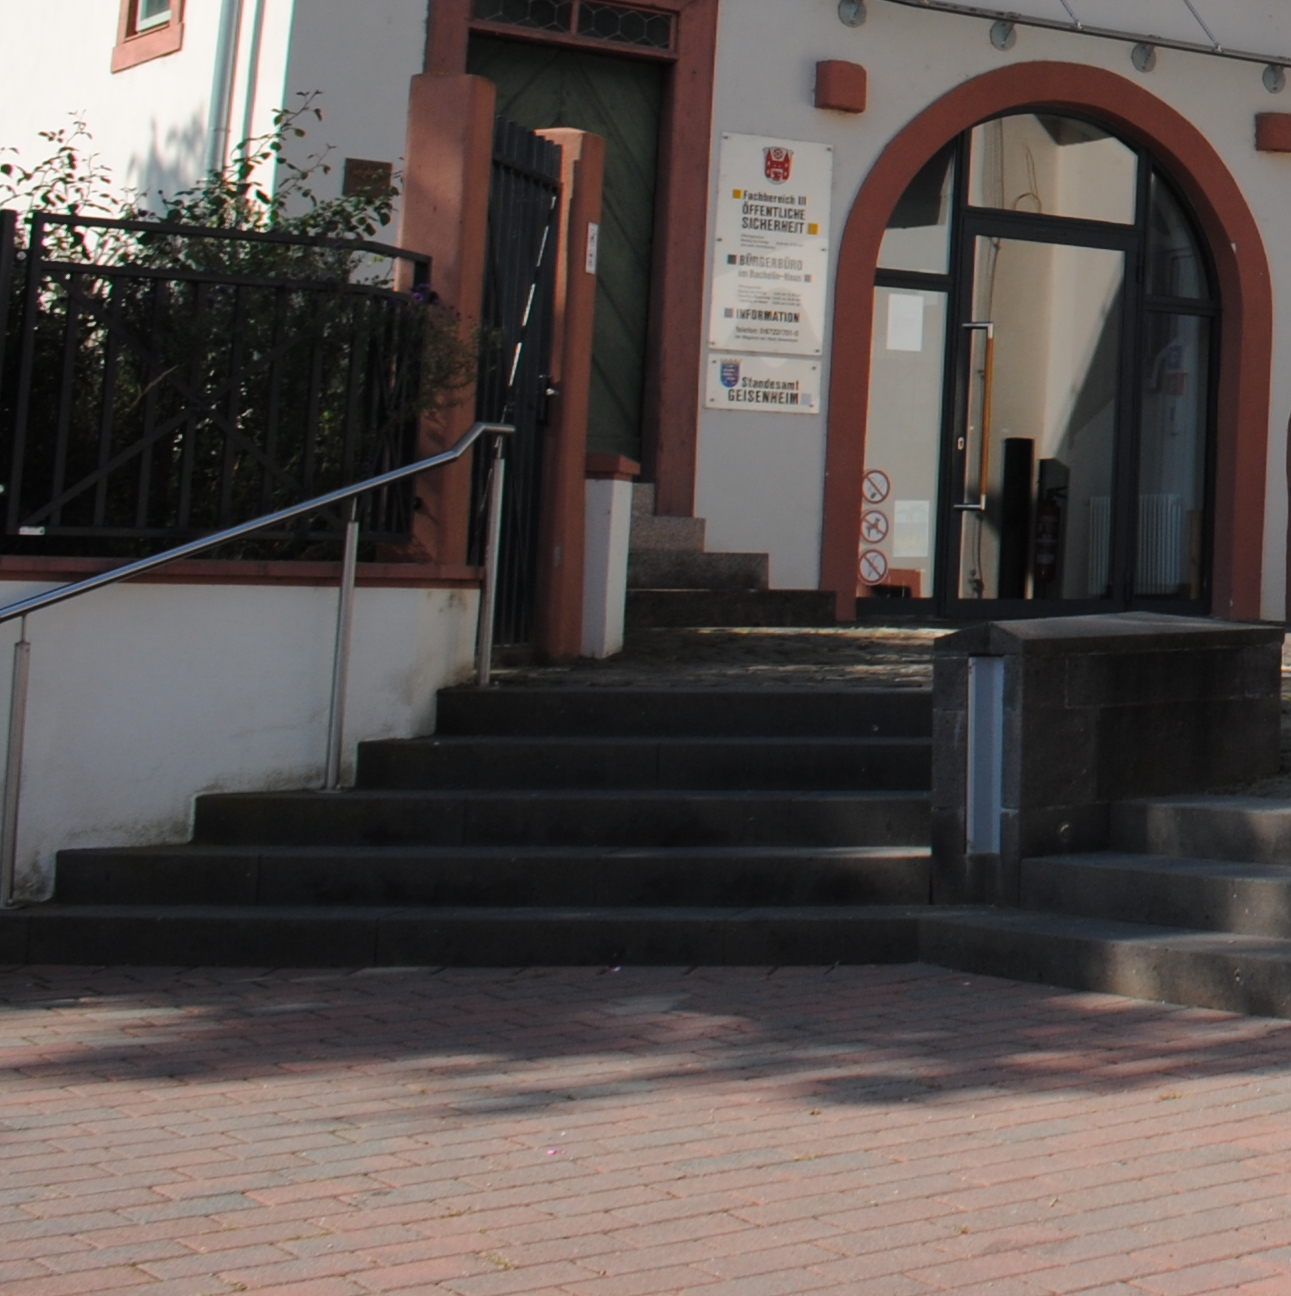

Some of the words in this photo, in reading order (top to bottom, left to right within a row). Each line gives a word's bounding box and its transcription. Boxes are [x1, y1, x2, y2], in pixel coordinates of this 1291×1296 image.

[743, 190, 795, 204] Fachbereich
[742, 202, 805, 220] ÖFFENTLICHE
[741, 217, 805, 234] SICHERHEIT
[739, 253, 803, 270] BÜRGERBÜRO
[736, 309, 800, 323] INFORMATION
[741, 376, 799, 391] Standesamt
[727, 389, 799, 405] GEISENHEIM
